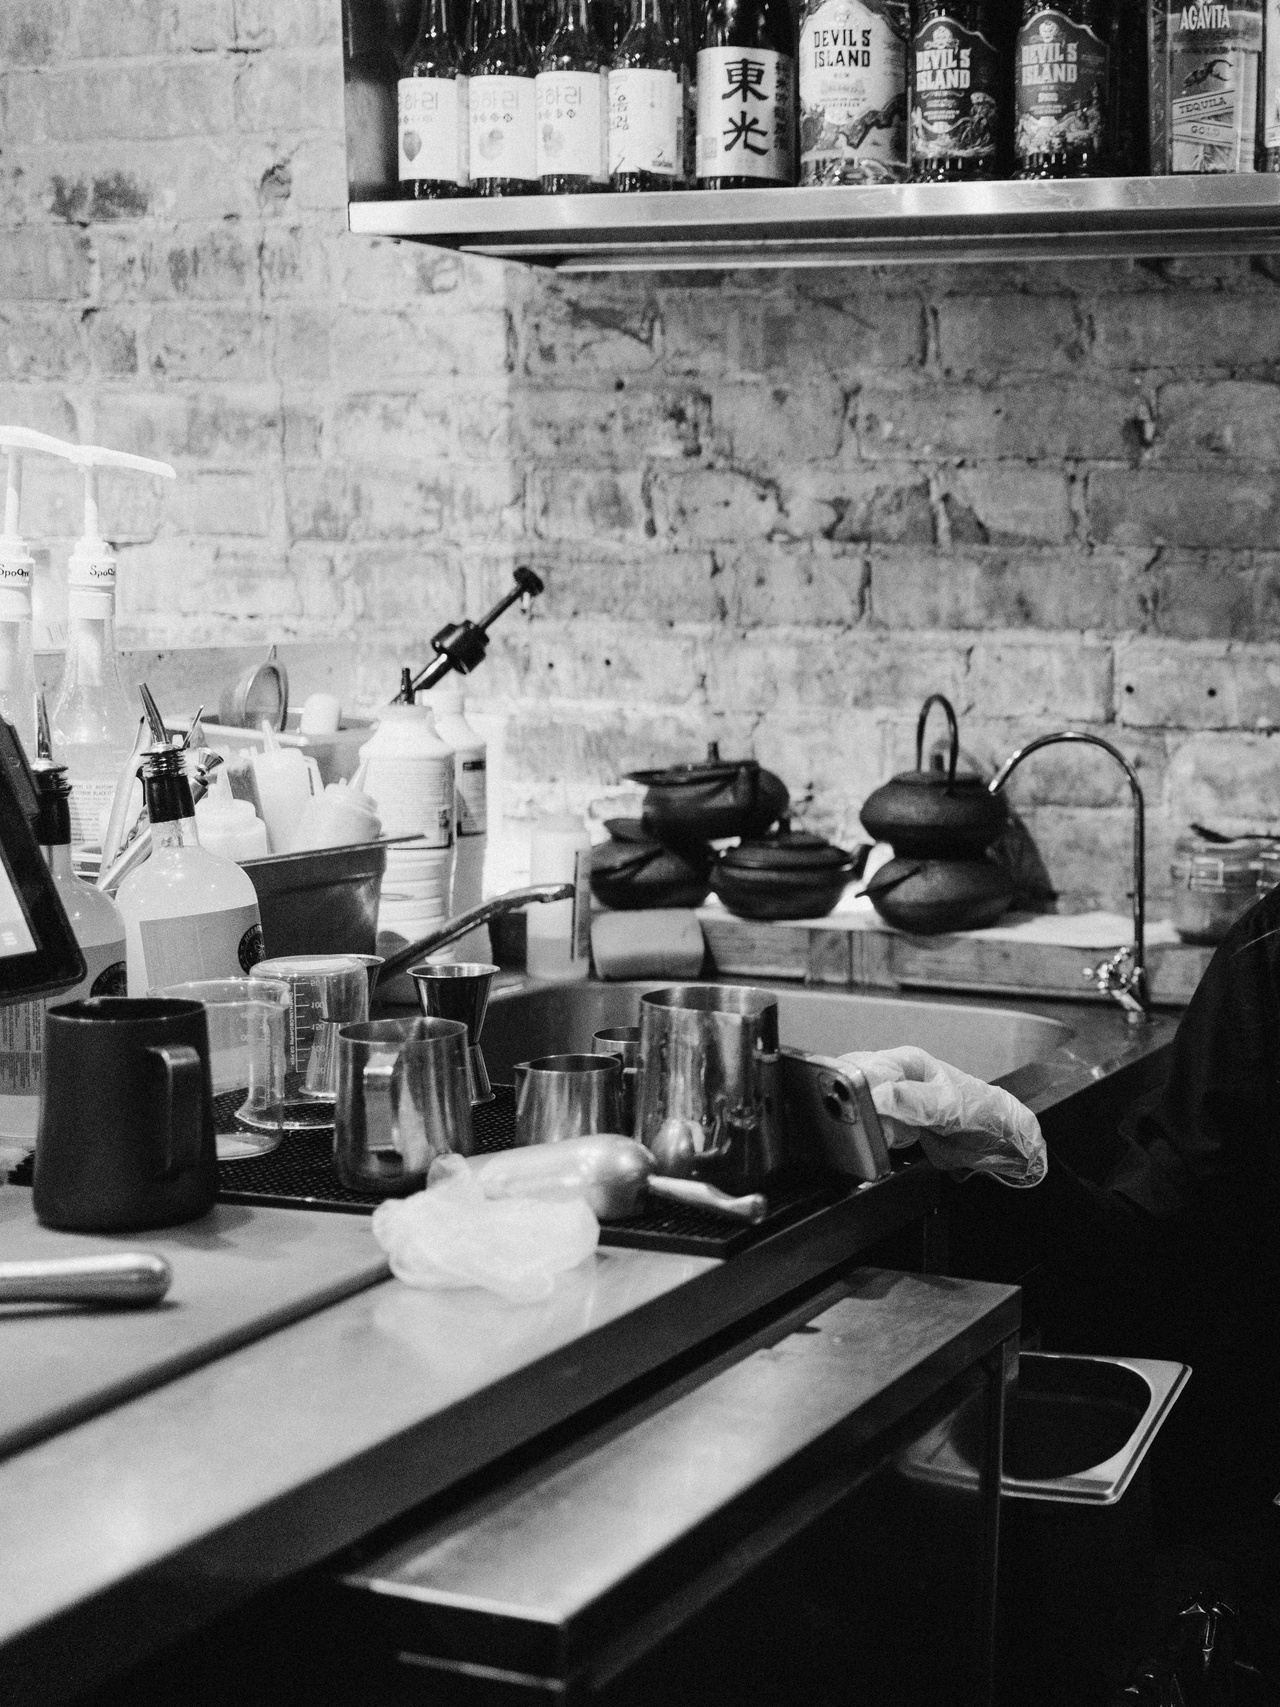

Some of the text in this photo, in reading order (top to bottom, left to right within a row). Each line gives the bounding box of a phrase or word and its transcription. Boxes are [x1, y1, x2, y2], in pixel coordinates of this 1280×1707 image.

[1180, 4, 1231, 30] AGAVITA
[814, 49, 871, 68] ISLAND
[916, 68, 971, 92] ISLAND
[1021, 63, 1078, 87] ISLAND
[721, 58, 769, 155] 東光
[1179, 97, 1227, 114] TEQUILA
